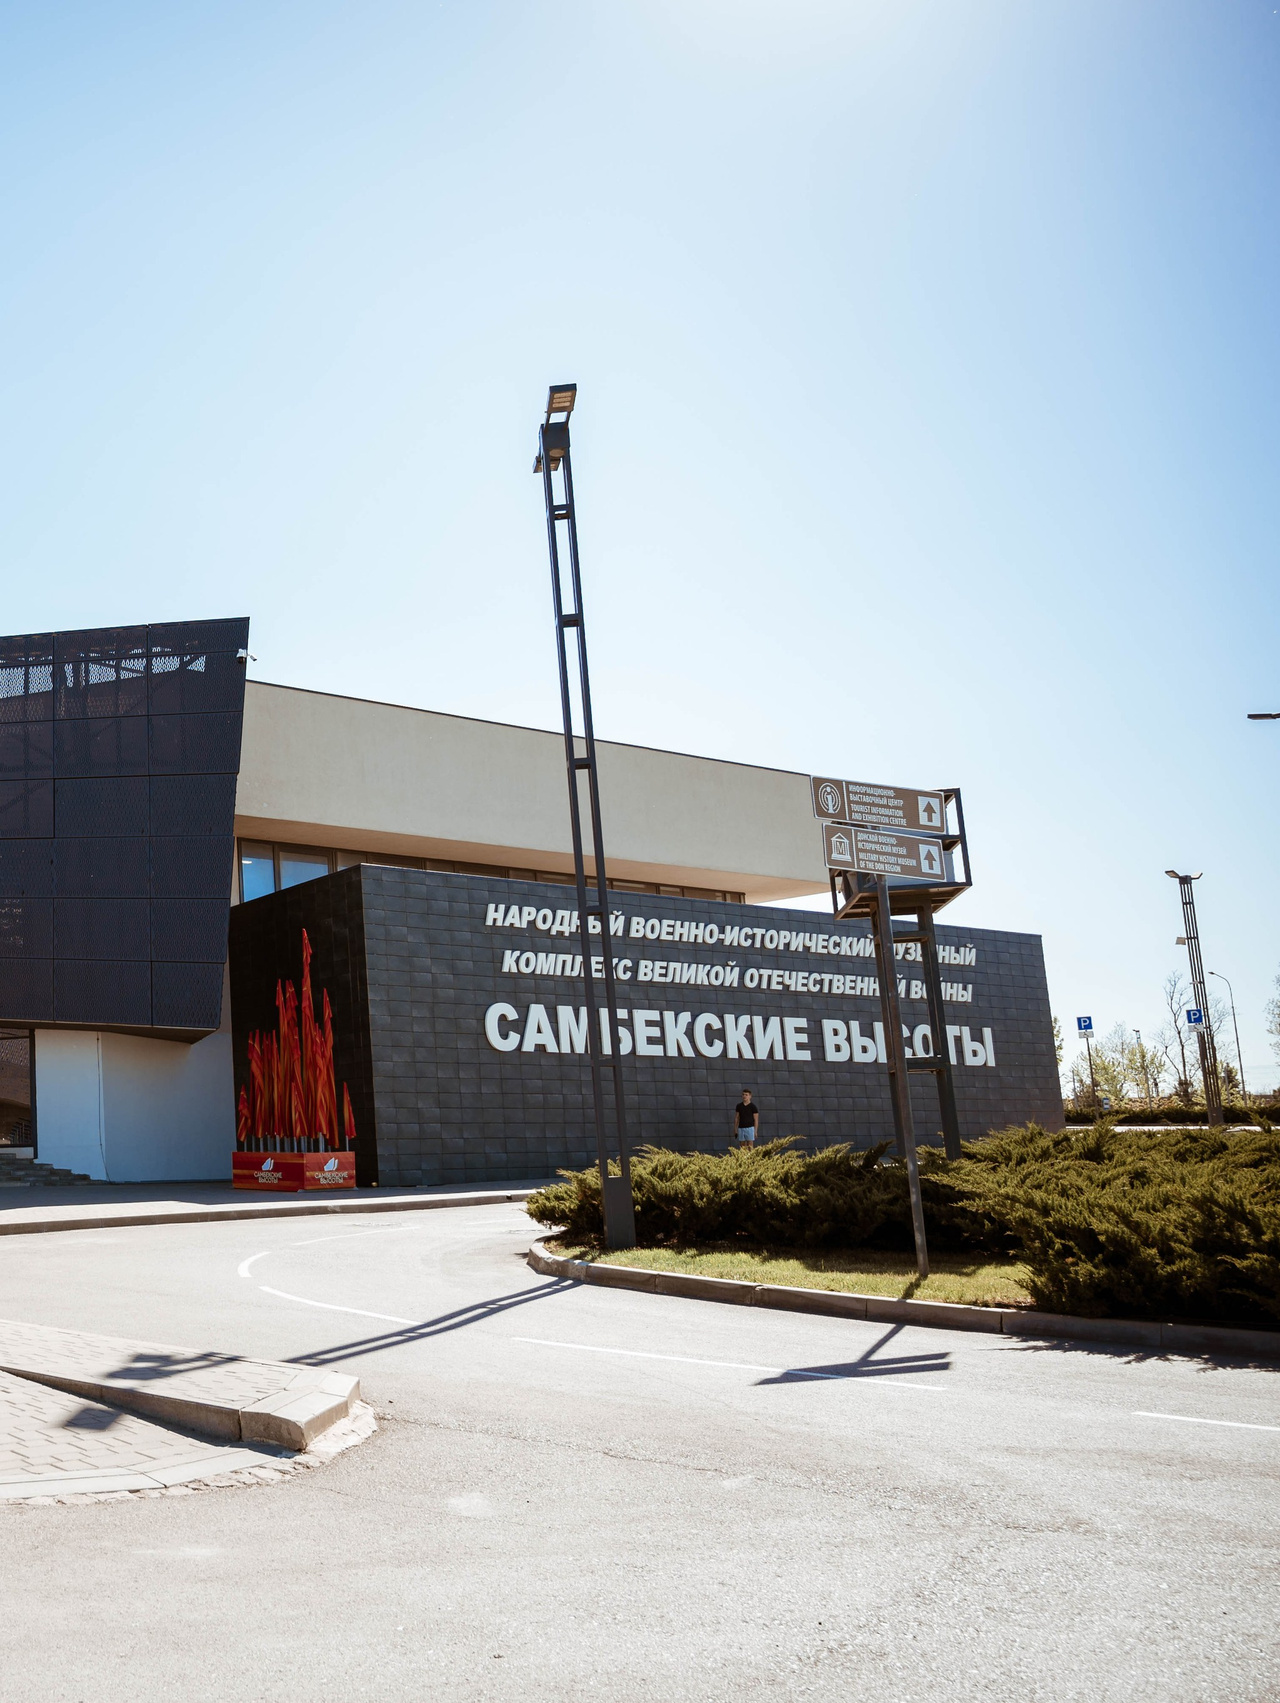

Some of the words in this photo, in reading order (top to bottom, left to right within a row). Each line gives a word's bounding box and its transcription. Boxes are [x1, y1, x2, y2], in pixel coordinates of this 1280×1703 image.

[852, 812, 862, 820] AND
[890, 817, 906, 826] CENTRE
[866, 861, 874, 869] THE
[875, 863, 884, 871] DON
[885, 864, 901, 872] REGION
[629, 916, 877, 958] ВОЕННО-ИСТОРИЧЕСКИЙ
[892, 942, 976, 966] УЗЕНЫЙ
[637, 959, 739, 987] ВЕЛИКОЙ
[743, 967, 907, 998] ОТЕЧЕСТВЕННЙ
